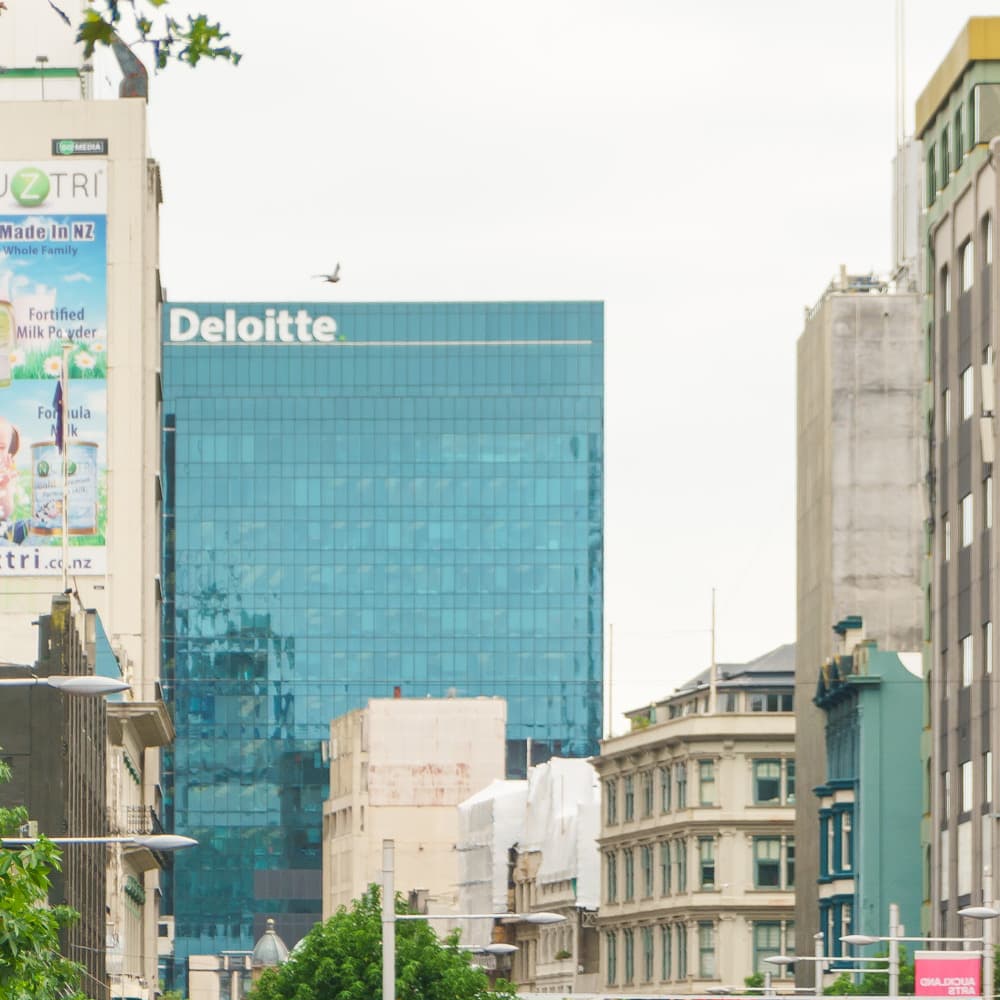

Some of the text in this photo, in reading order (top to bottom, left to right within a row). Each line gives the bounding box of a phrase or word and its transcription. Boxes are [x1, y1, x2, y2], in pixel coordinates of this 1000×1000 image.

[75, 144, 101, 152] MEDIA
[0, 224, 94, 239] Made In NZ
[3, 245, 78, 257] Whole Family
[29, 307, 85, 321] Fortified
[17, 326, 44, 339] Milk
[38, 406, 91, 419] Forula
[51, 424, 78, 437] Mlk
